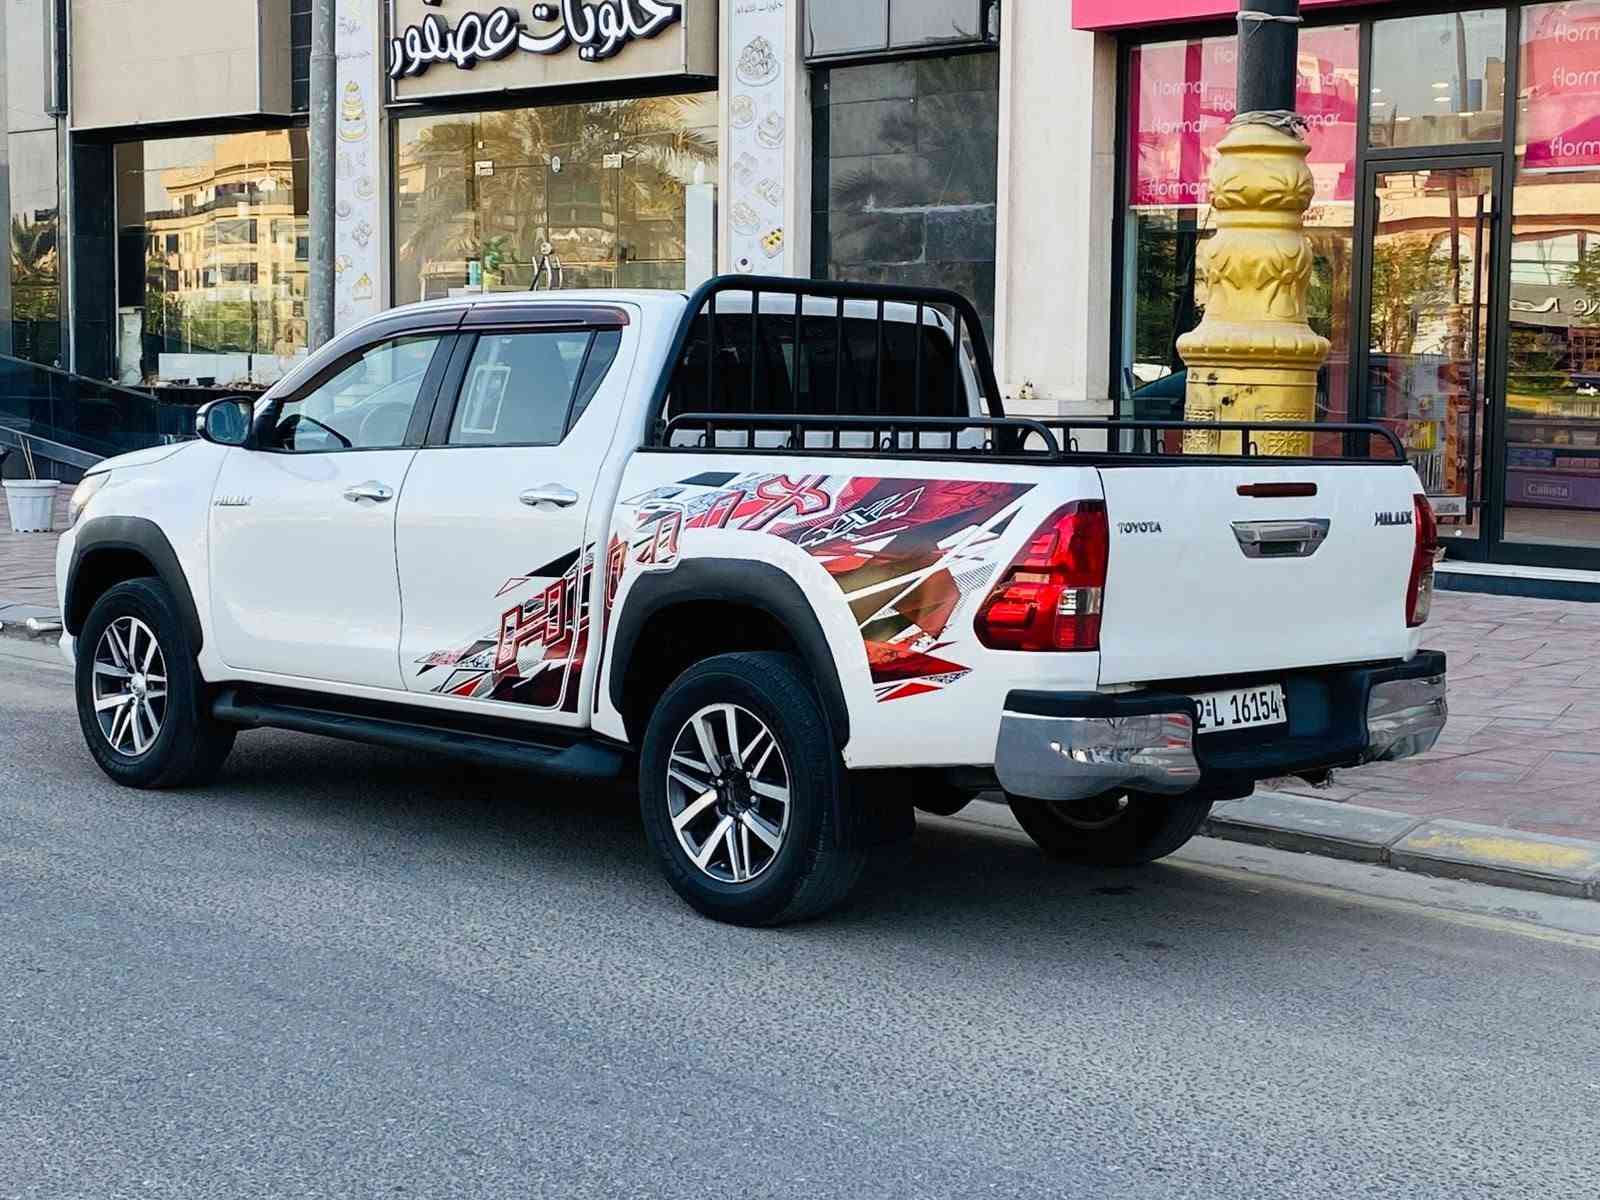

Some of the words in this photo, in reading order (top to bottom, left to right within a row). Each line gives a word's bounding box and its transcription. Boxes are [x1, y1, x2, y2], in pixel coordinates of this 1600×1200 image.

[517, 0, 675, 60] حلويات
[389, 3, 516, 77] عصفور
[1152, 80, 1208, 97] flormar
[1151, 115, 1208, 135] flormar
[1149, 177, 1208, 196] flormar
[1118, 521, 1162, 534] TOYOTA
[1374, 511, 1412, 526] HILUX
[1230, 690, 1280, 724] 16154
